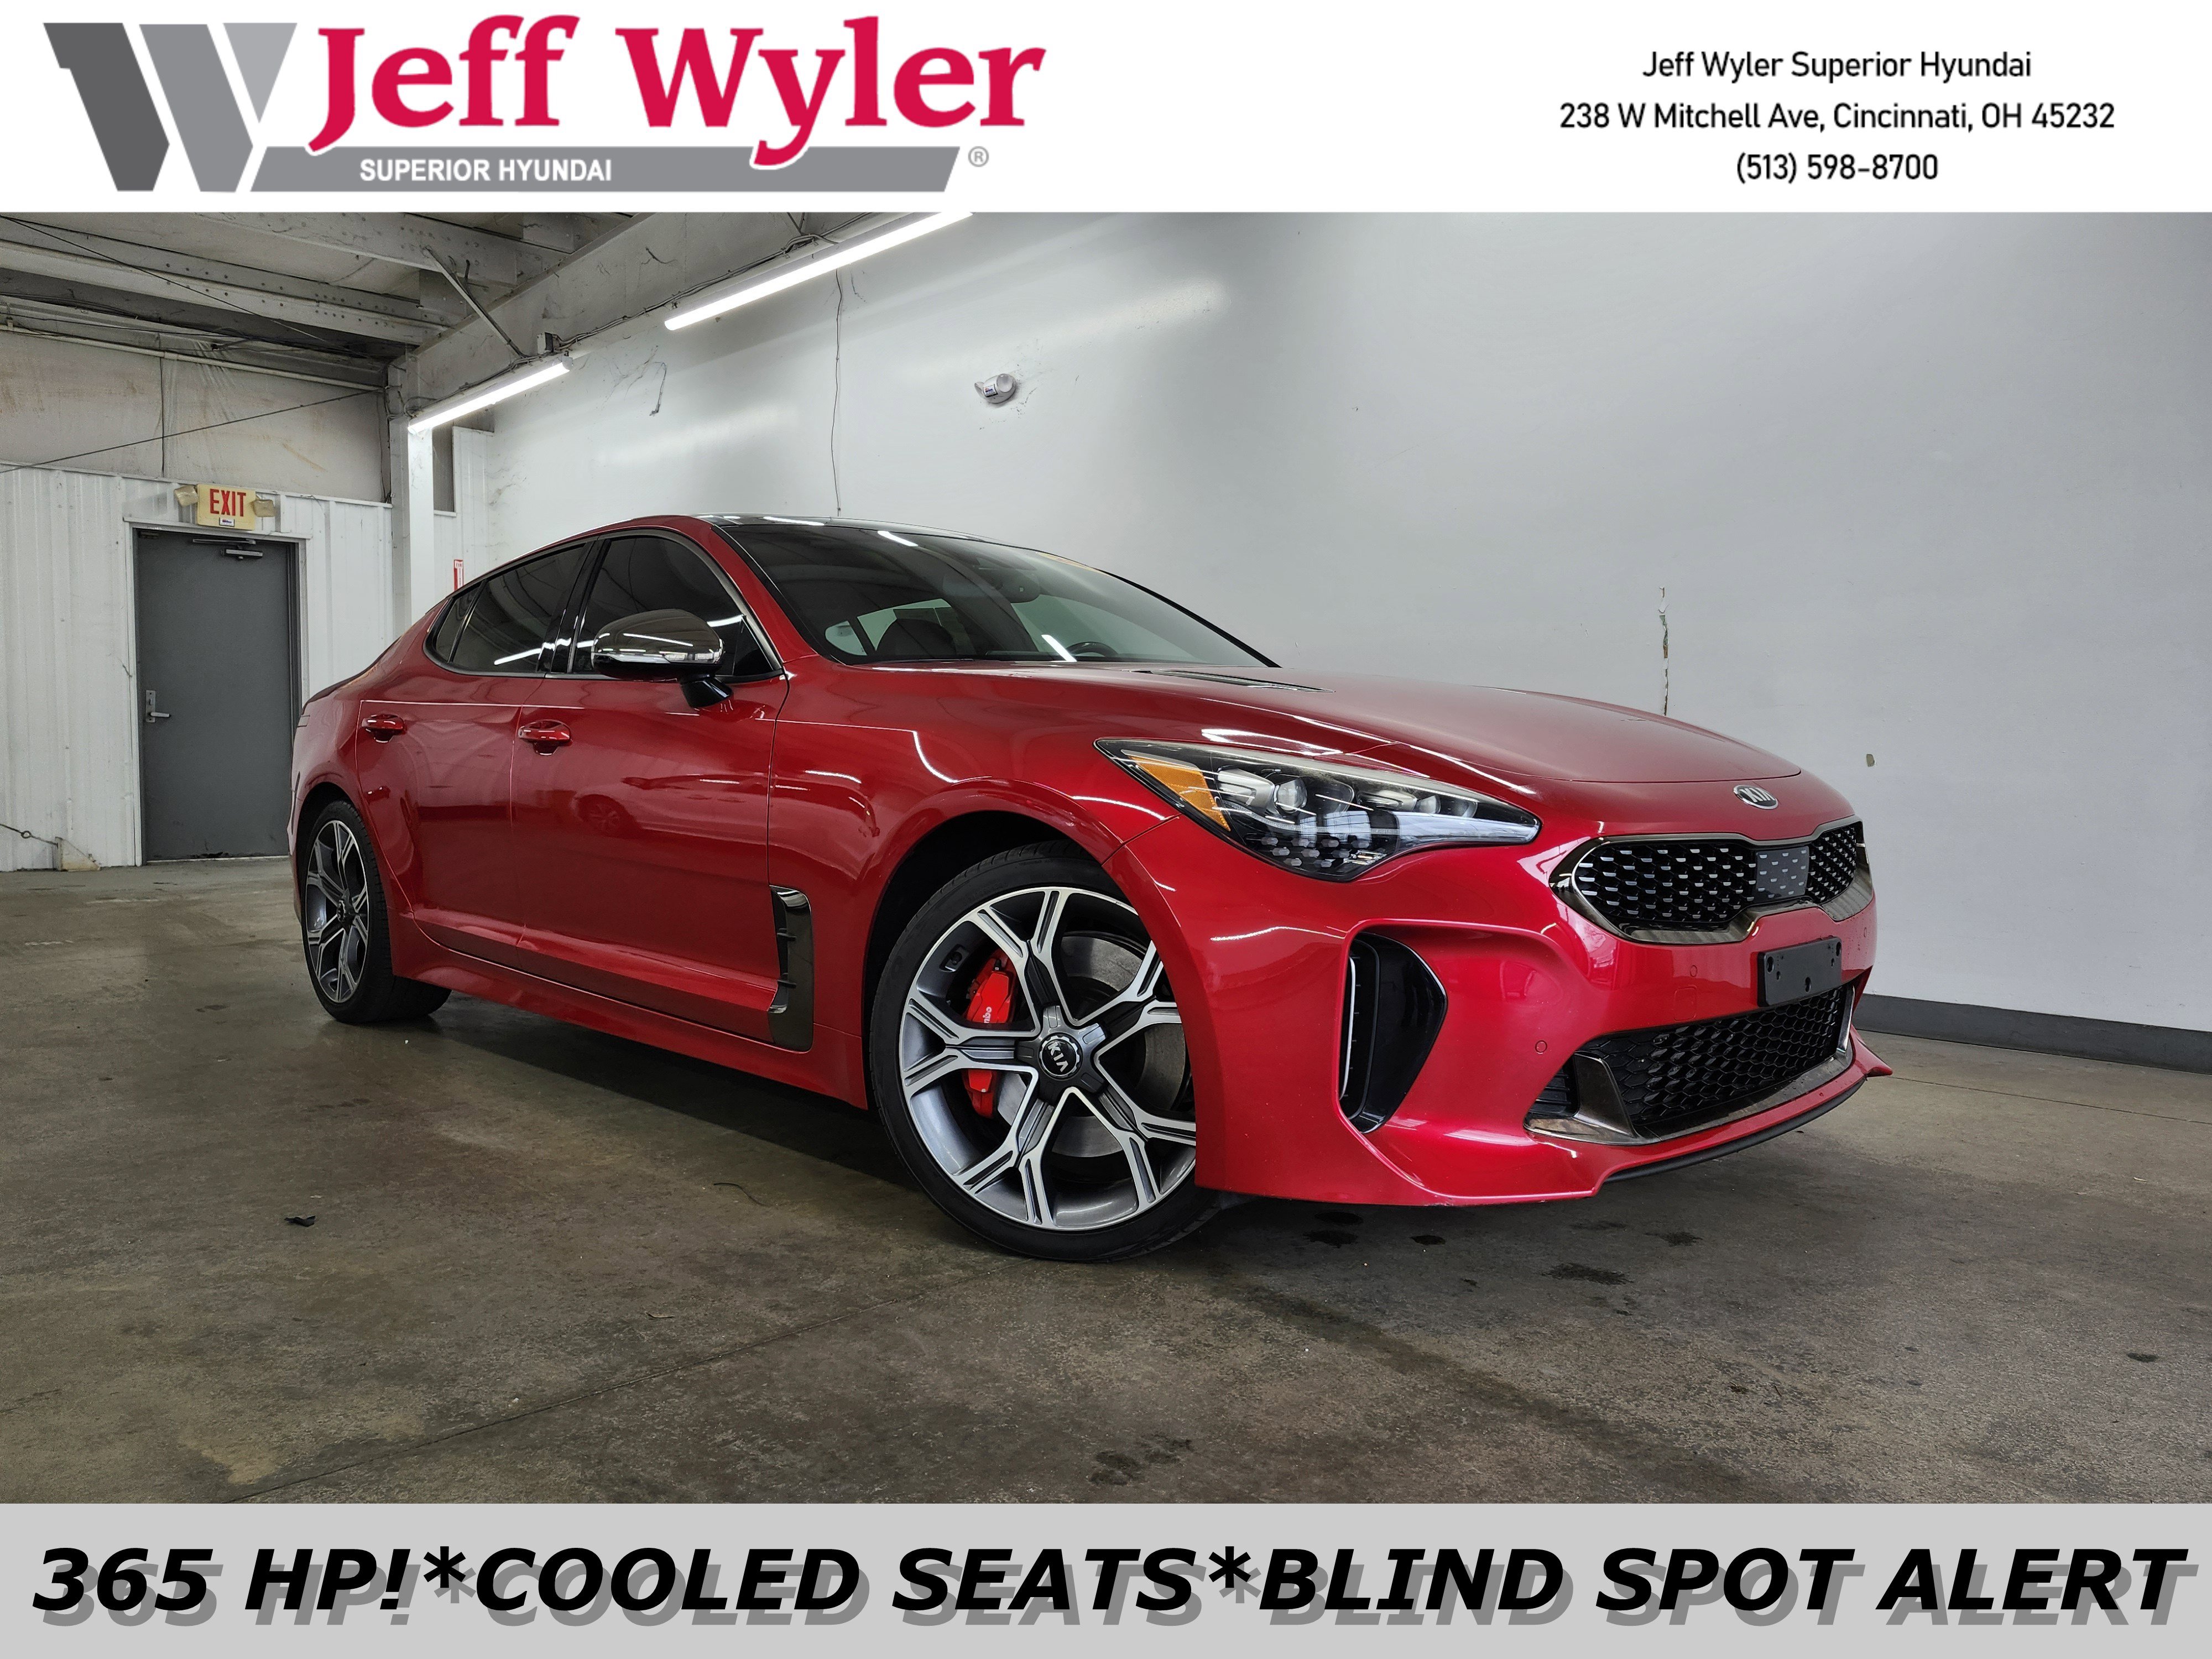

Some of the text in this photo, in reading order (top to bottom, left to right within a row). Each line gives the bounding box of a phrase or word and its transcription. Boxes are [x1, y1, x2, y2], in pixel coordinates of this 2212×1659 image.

[210, 488, 247, 517] EXIT
[1739, 787, 1776, 802] KIA
[1047, 1041, 1068, 1072] KIA
